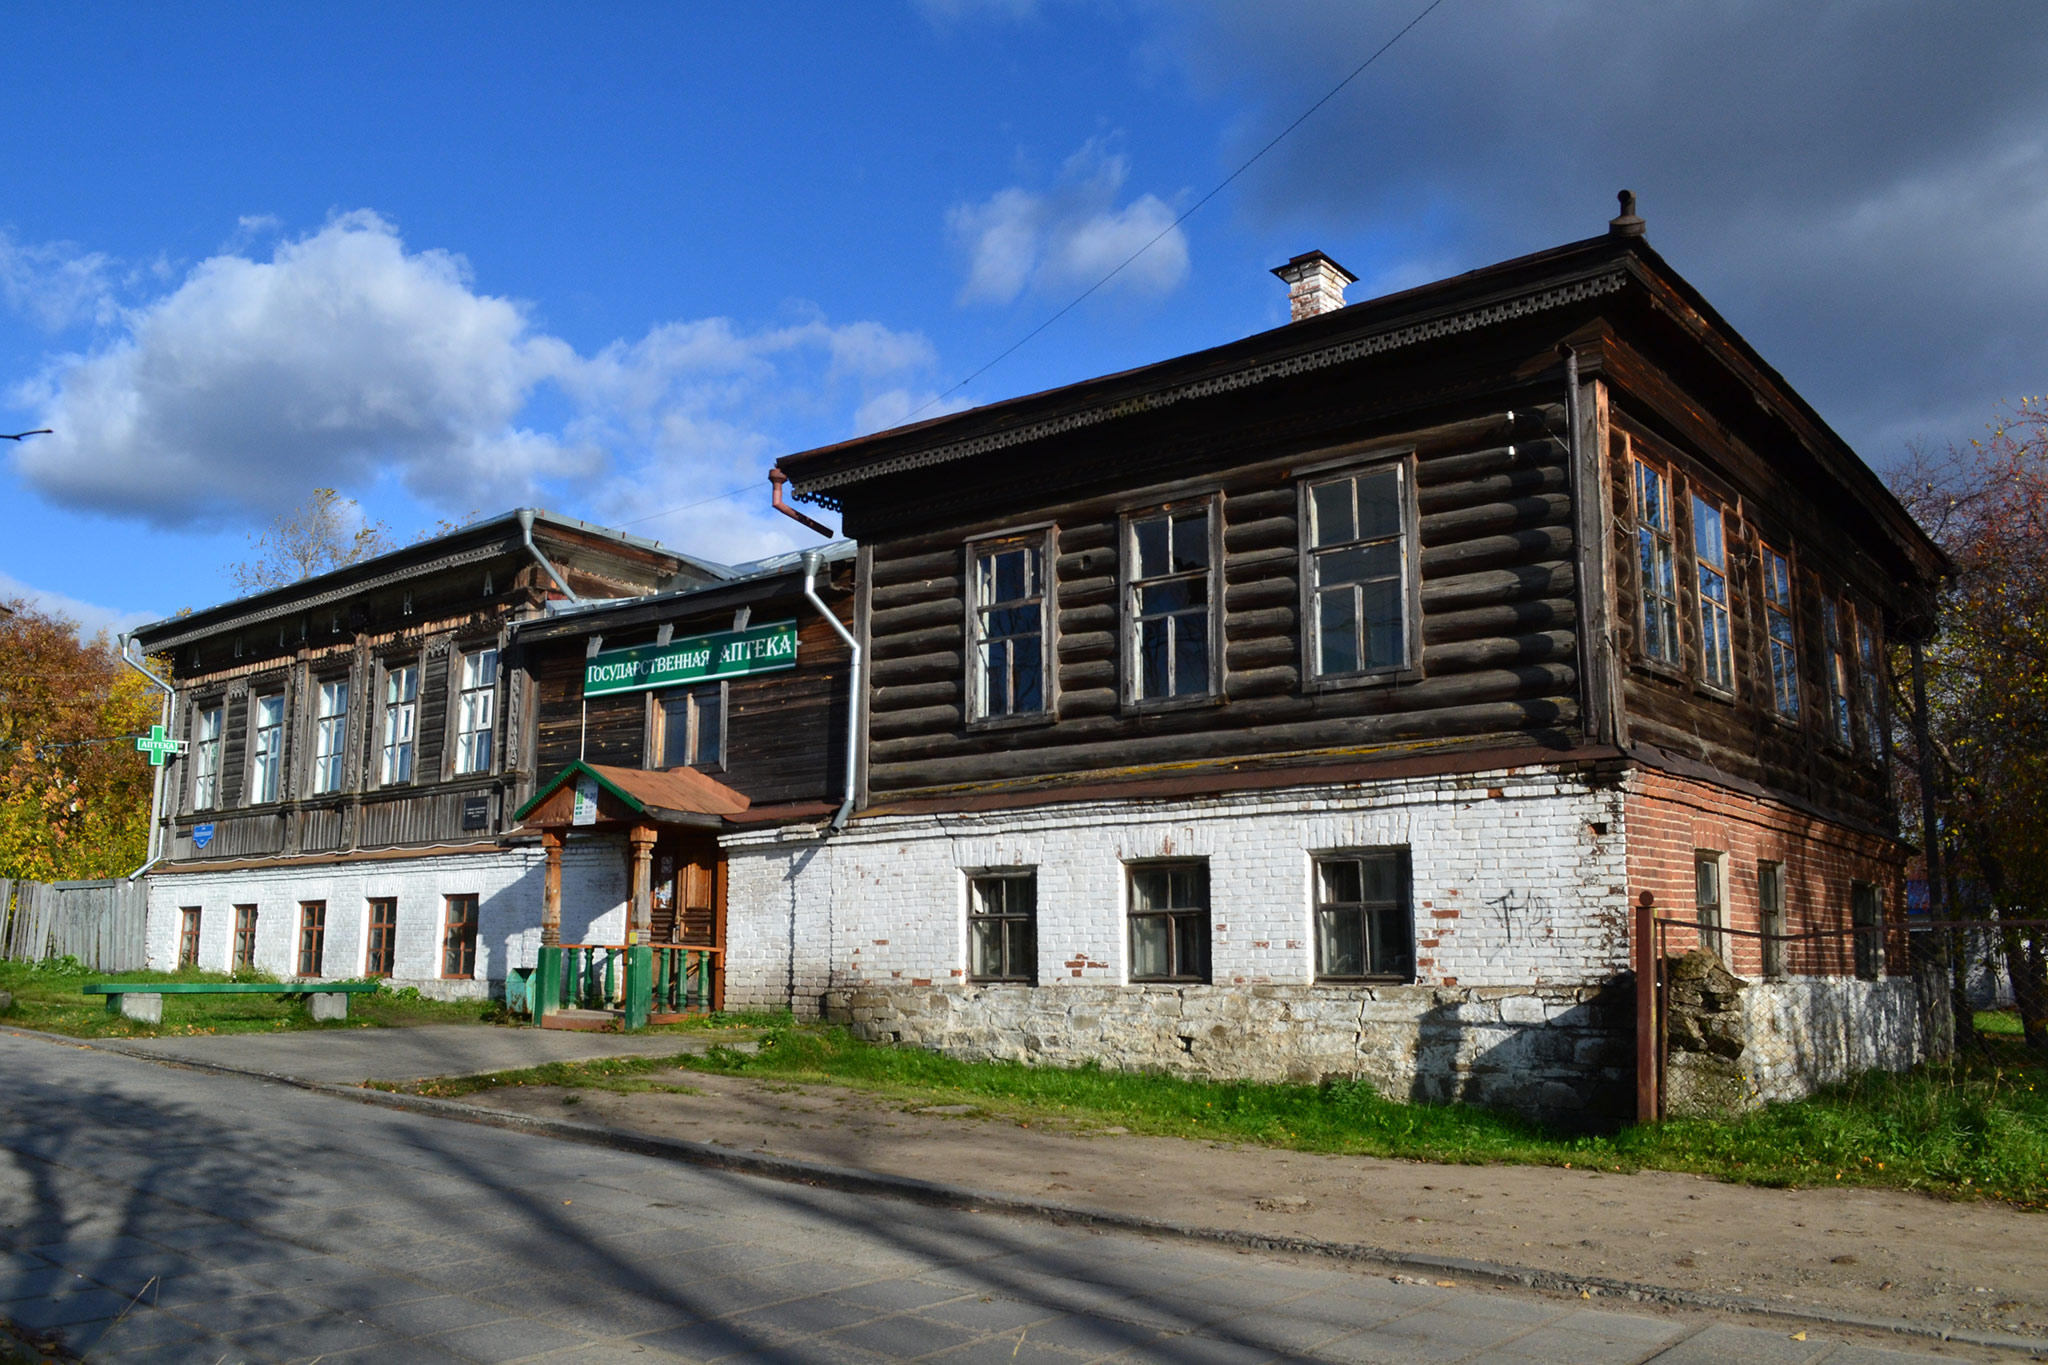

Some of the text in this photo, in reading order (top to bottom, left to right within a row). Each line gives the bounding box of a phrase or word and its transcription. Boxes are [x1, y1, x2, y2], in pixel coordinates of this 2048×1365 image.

[587, 634, 792, 683] ГОСУДАРСТВЕННАЯ АПТЕКА
[141, 740, 175, 750] АПТЕКА
